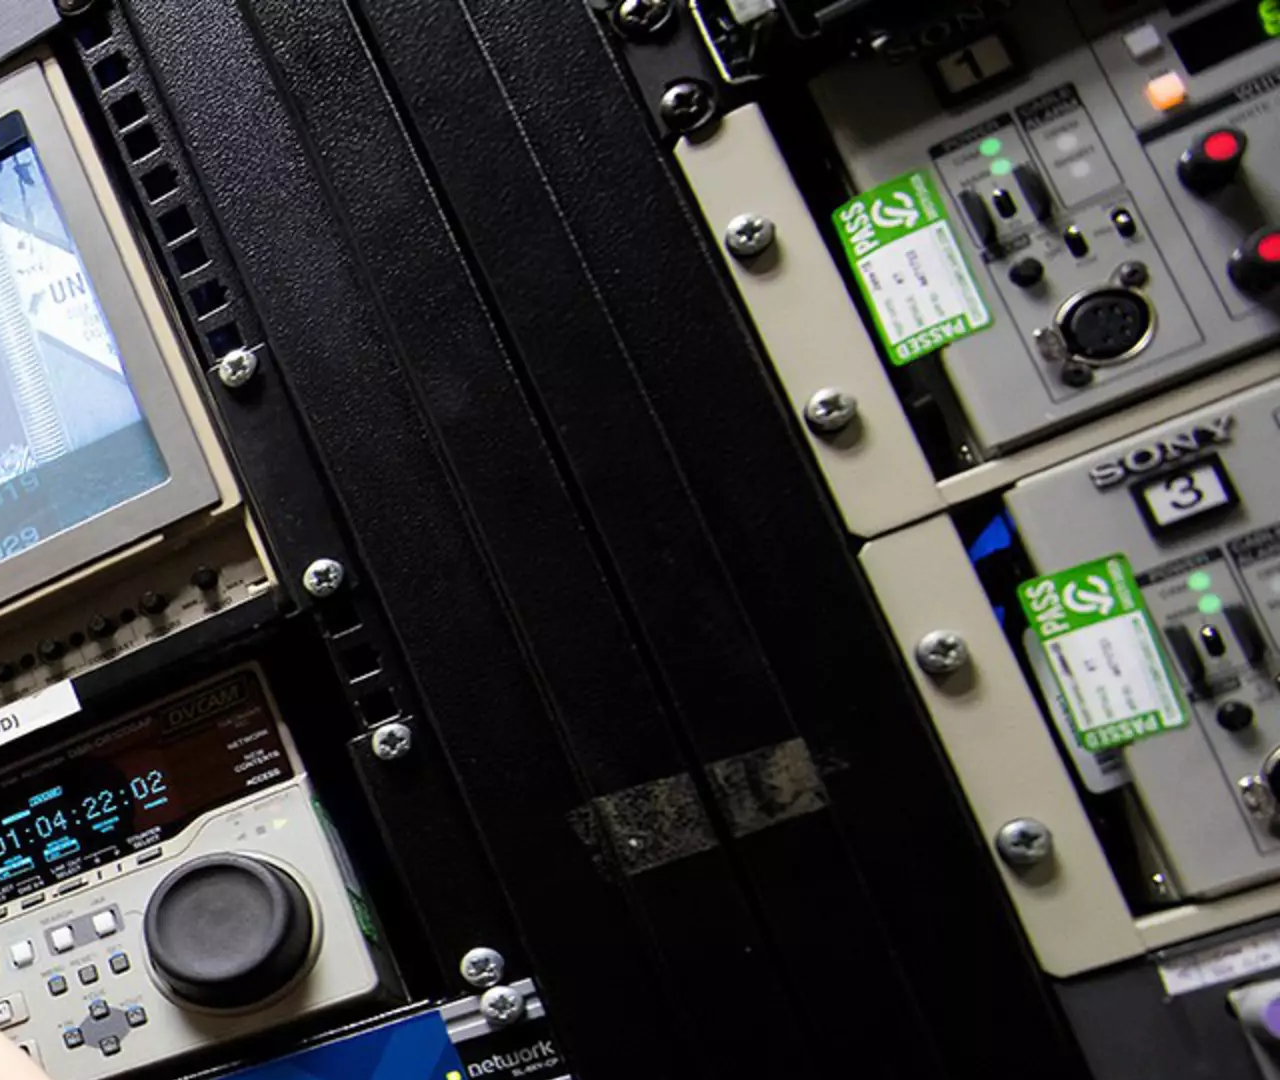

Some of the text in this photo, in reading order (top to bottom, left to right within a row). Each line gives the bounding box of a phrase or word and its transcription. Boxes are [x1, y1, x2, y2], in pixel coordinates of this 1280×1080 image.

[953, 52, 985, 80] 1
[842, 202, 878, 257] PASS
[49, 271, 87, 306] UN
[898, 316, 966, 359] PASSED
[1090, 413, 1236, 490] SONY
[1165, 475, 1203, 509] 3
[1026, 579, 1070, 636] PASS
[169, 683, 240, 727] DVCAM
[226, 728, 270, 751] NETWORK
[233, 750, 282, 774] CONTENTS
[245, 767, 281, 786] ACCESS
[467, 1040, 556, 1079] network
